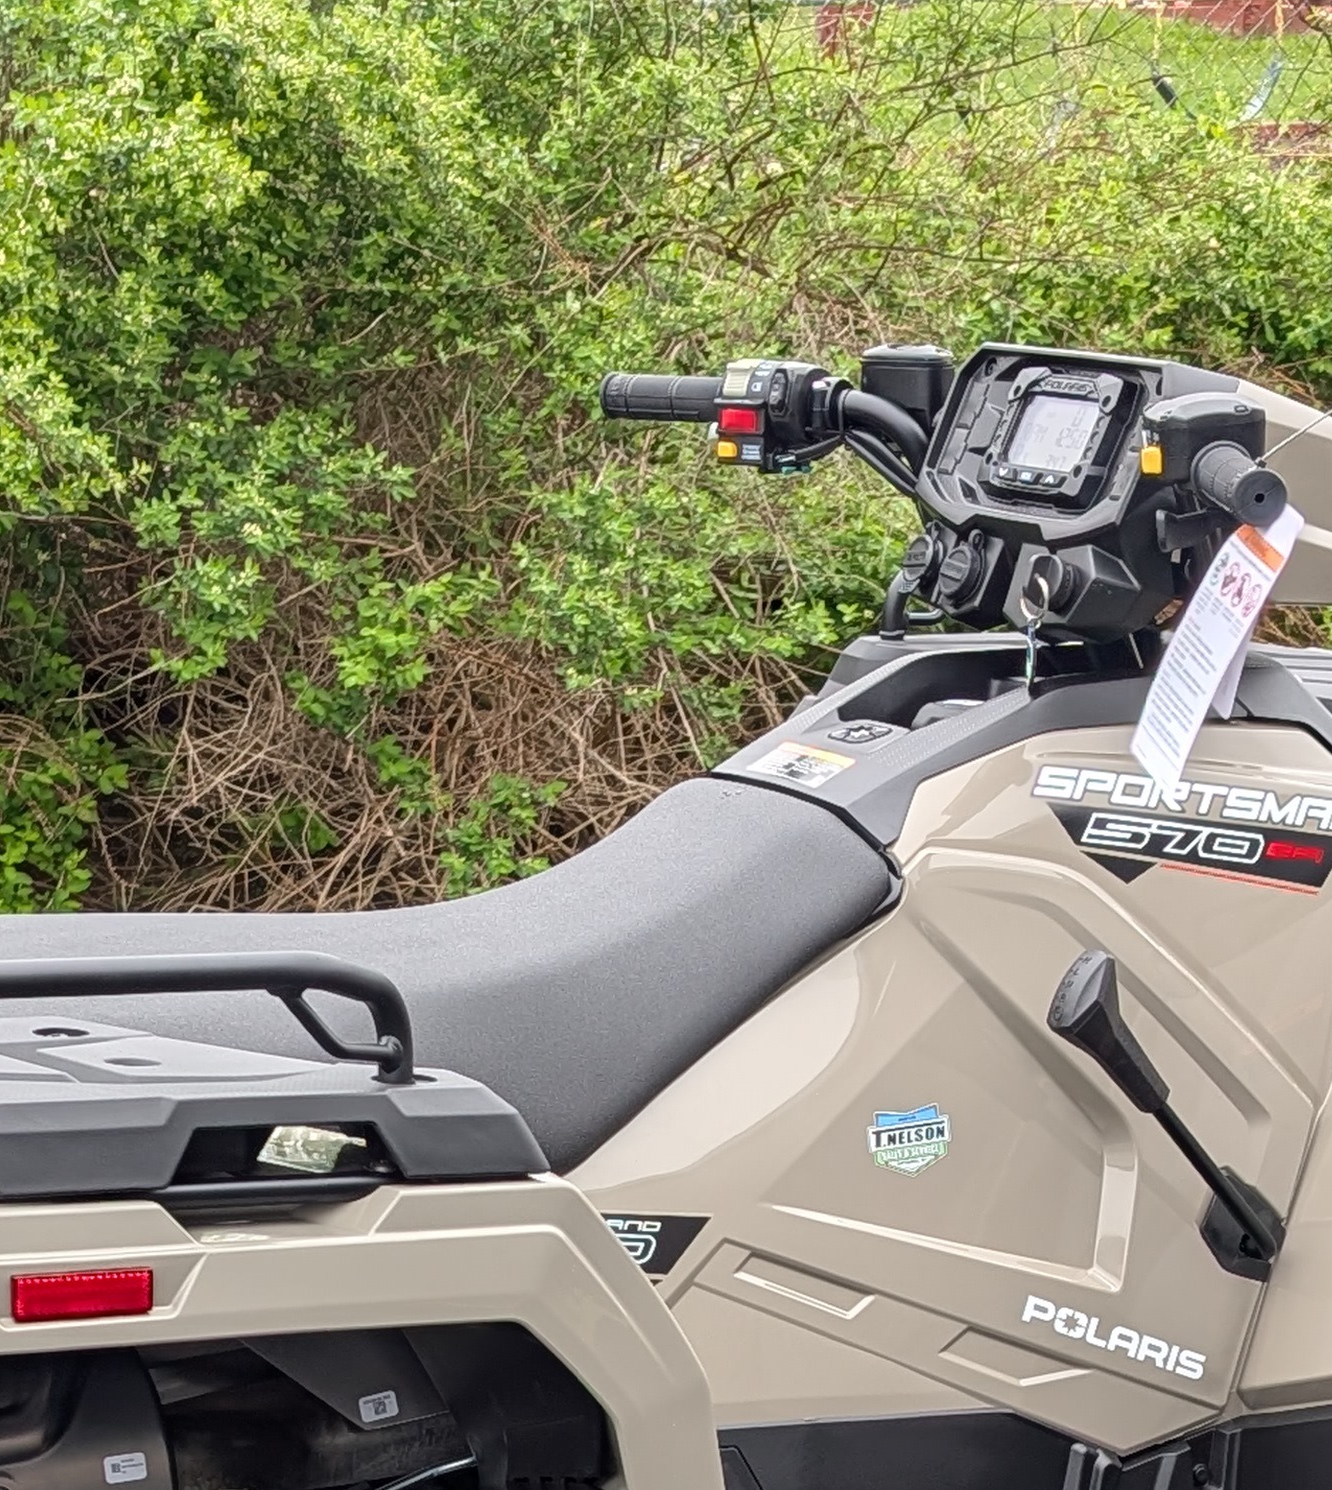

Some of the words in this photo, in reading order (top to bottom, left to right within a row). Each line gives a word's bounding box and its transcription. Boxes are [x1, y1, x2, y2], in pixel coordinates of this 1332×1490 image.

[1080, 812, 1265, 865] 570
[872, 1120, 946, 1148] T.NELSON
[1021, 1295, 1207, 1381] POLARIS
